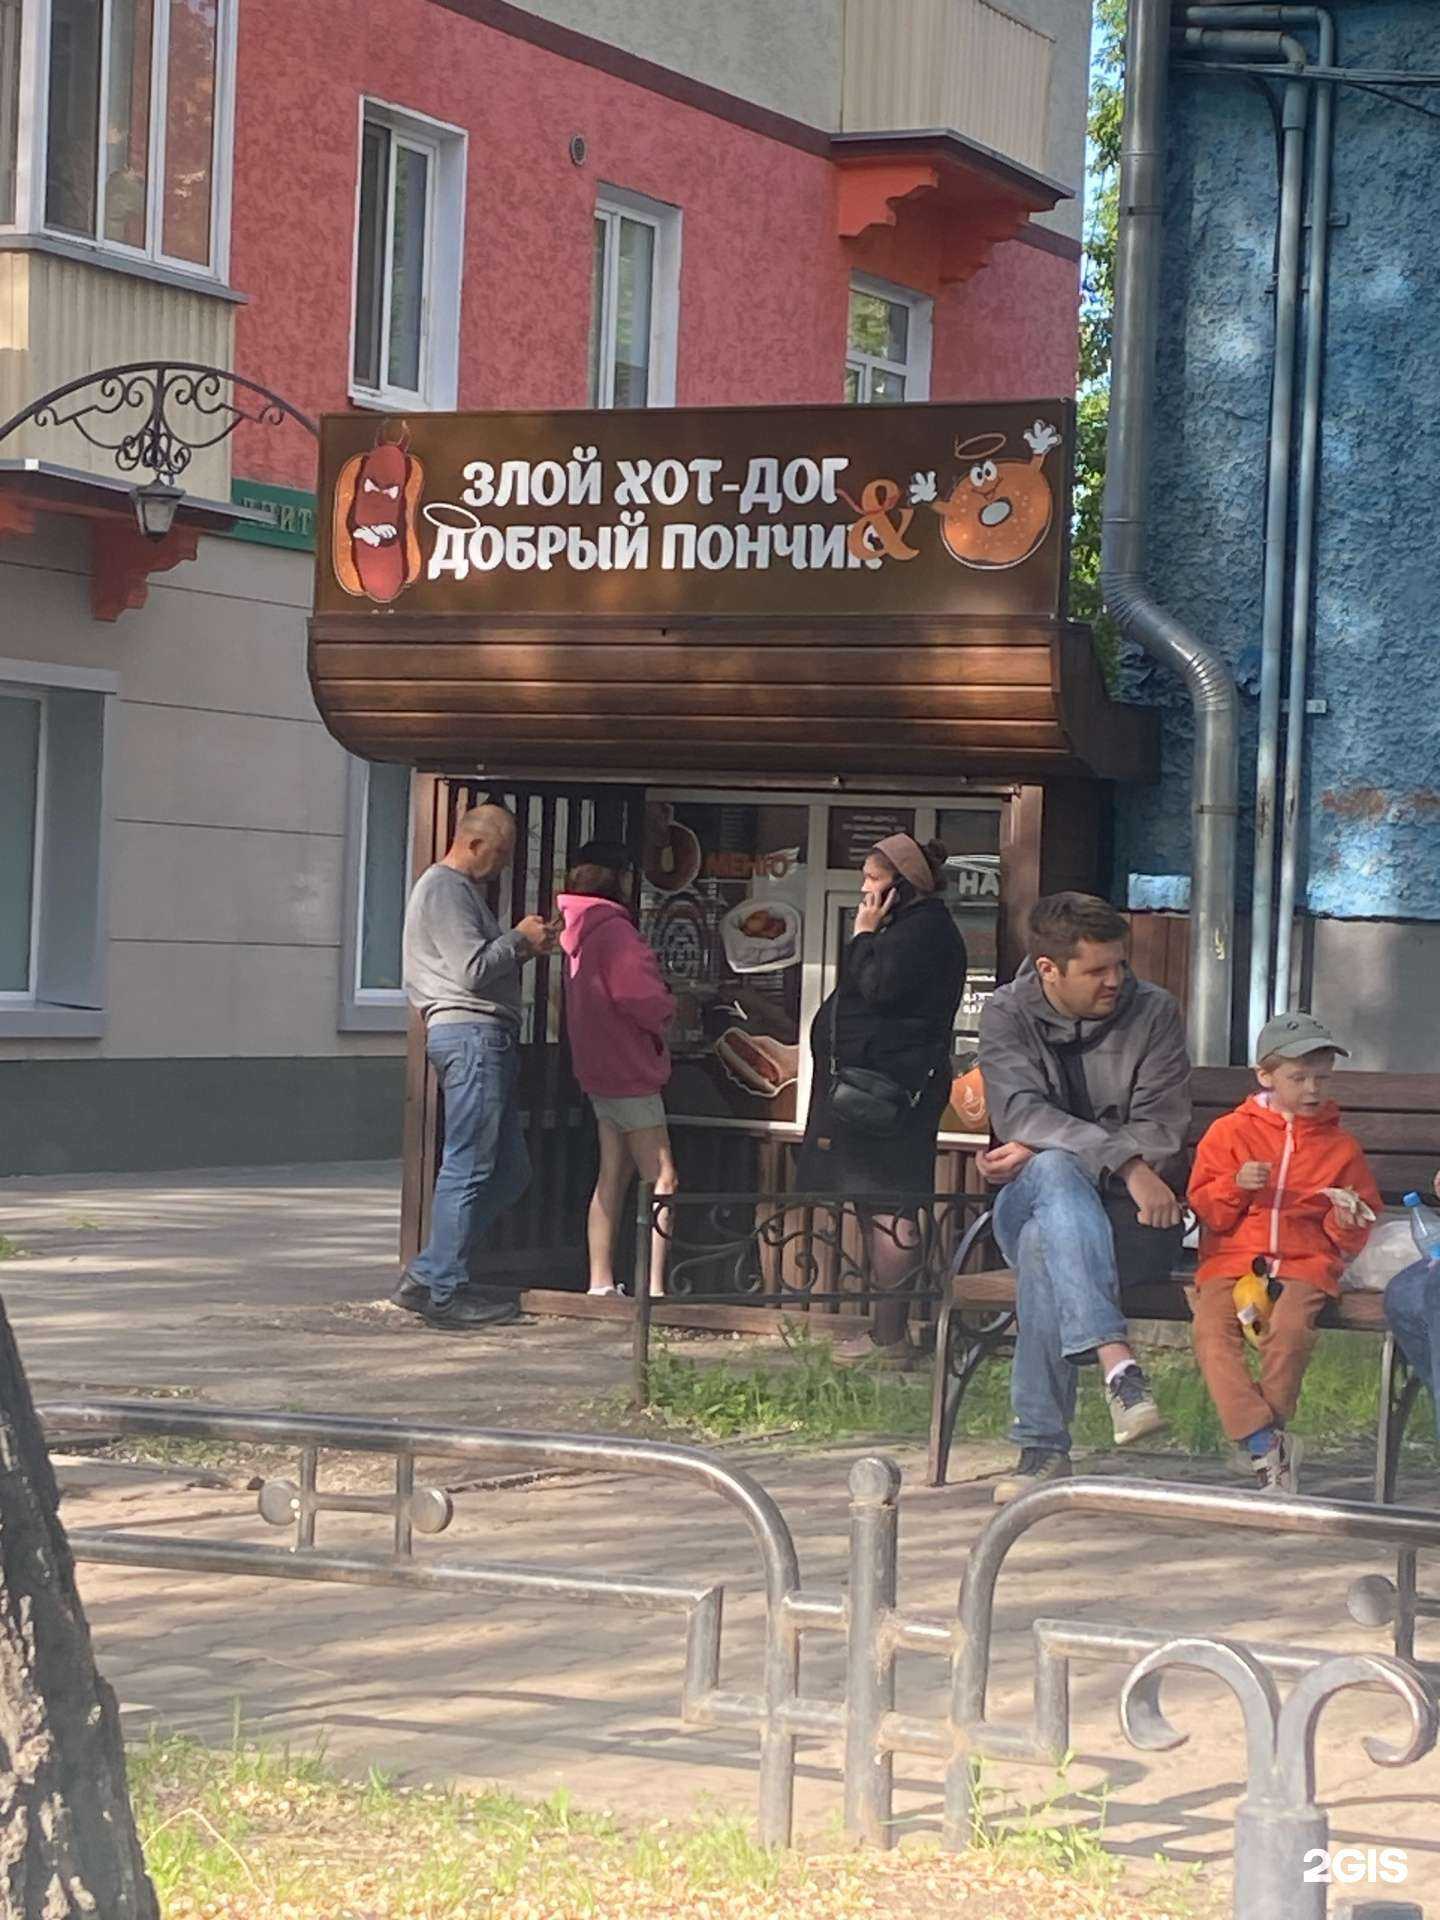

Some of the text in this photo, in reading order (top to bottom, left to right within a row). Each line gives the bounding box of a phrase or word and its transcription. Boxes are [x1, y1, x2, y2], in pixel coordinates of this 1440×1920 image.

[462, 446, 850, 515] ЗЛОЙ ХОТ-ДОГ
[427, 510, 649, 580] ДОБРЫЙ
